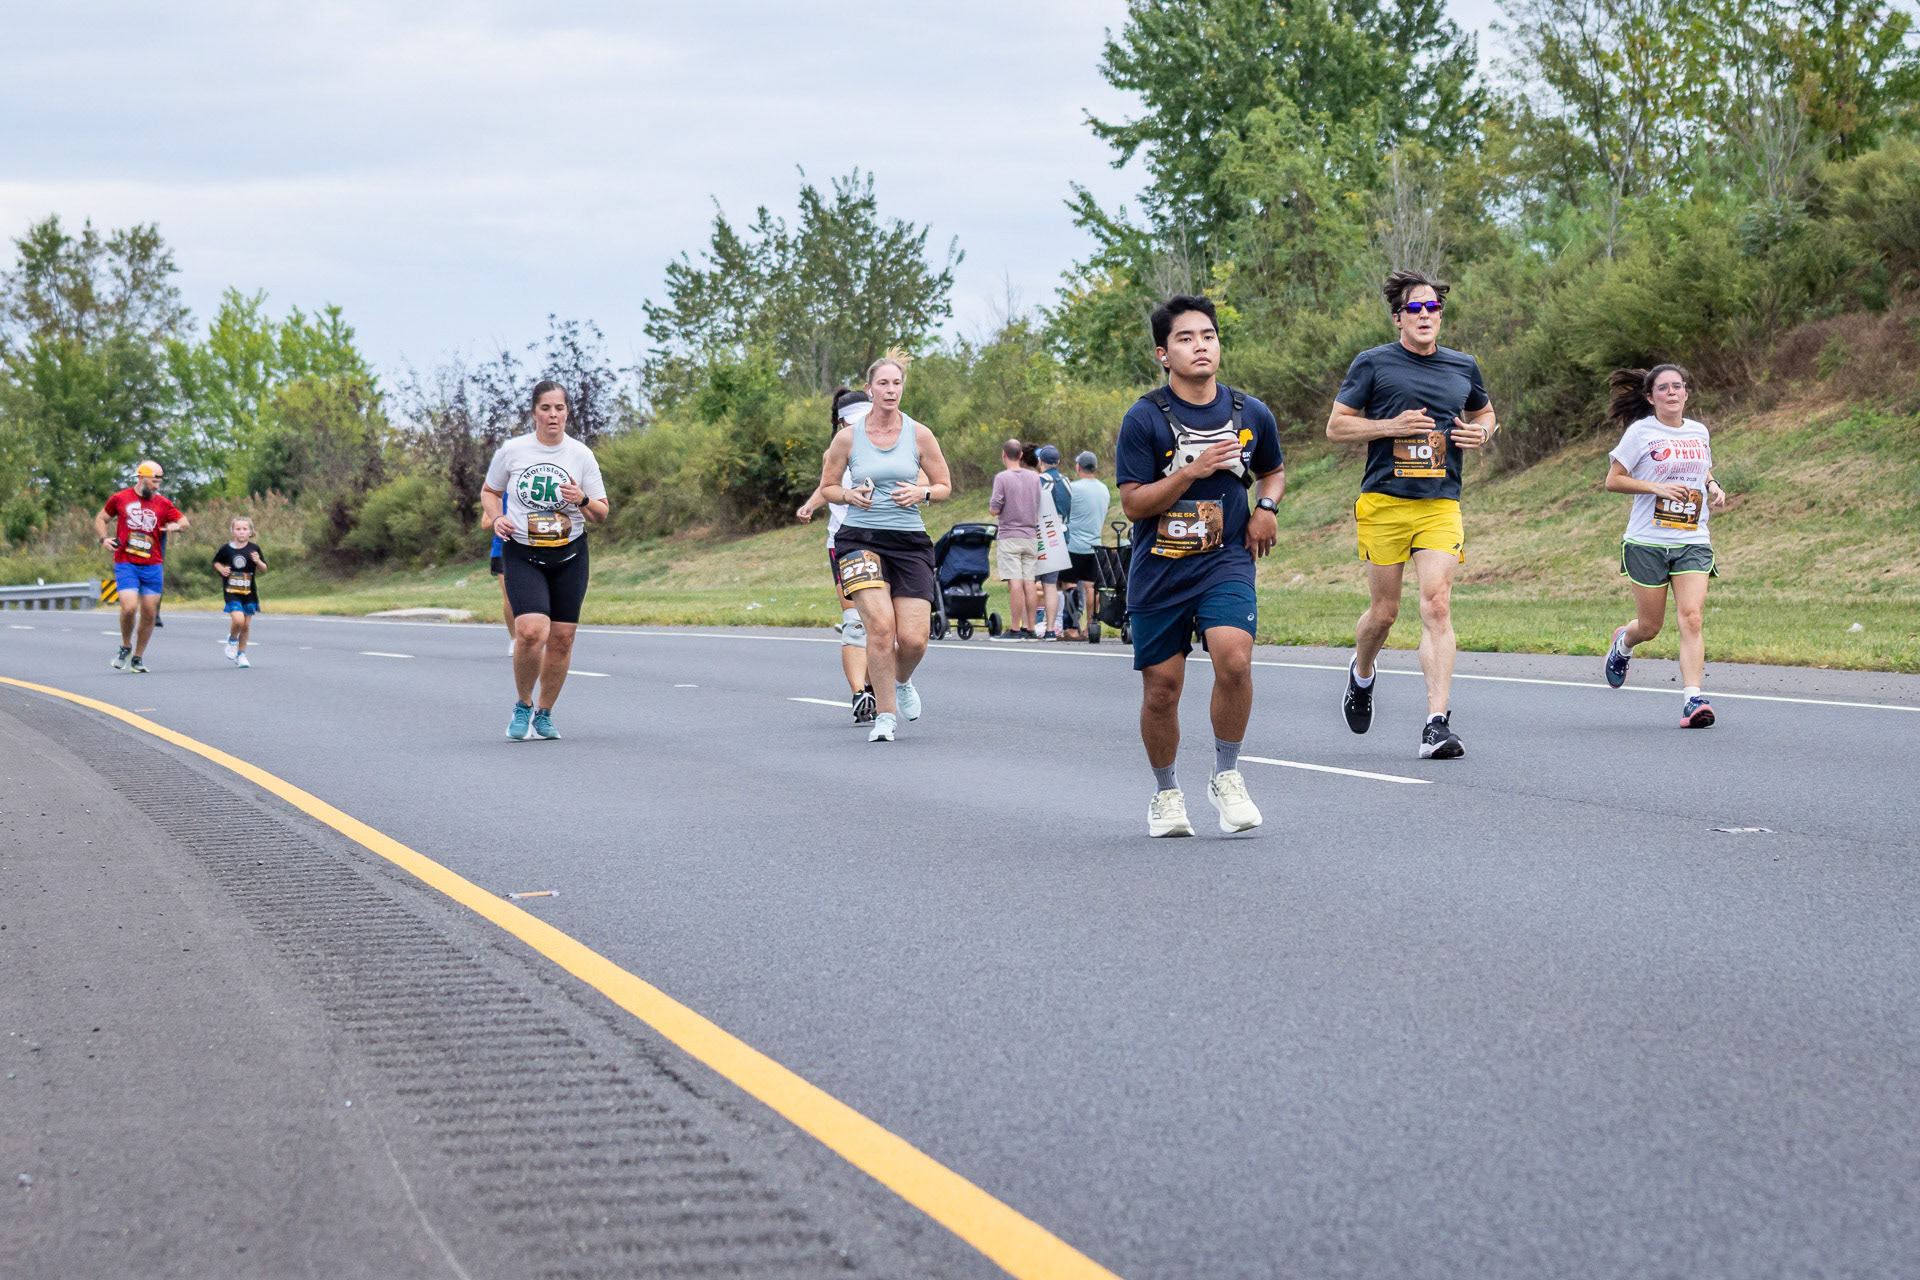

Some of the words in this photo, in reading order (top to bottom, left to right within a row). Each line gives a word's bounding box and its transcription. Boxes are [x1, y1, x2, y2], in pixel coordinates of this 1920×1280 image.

[1407, 445, 1433, 460] 10
[523, 465, 568, 484] Morristown
[554, 498, 567, 510] Da
[1662, 499, 1697, 515] 162
[537, 521, 563, 534] 54
[1167, 520, 1208, 538] 64
[843, 561, 879, 581] 273
